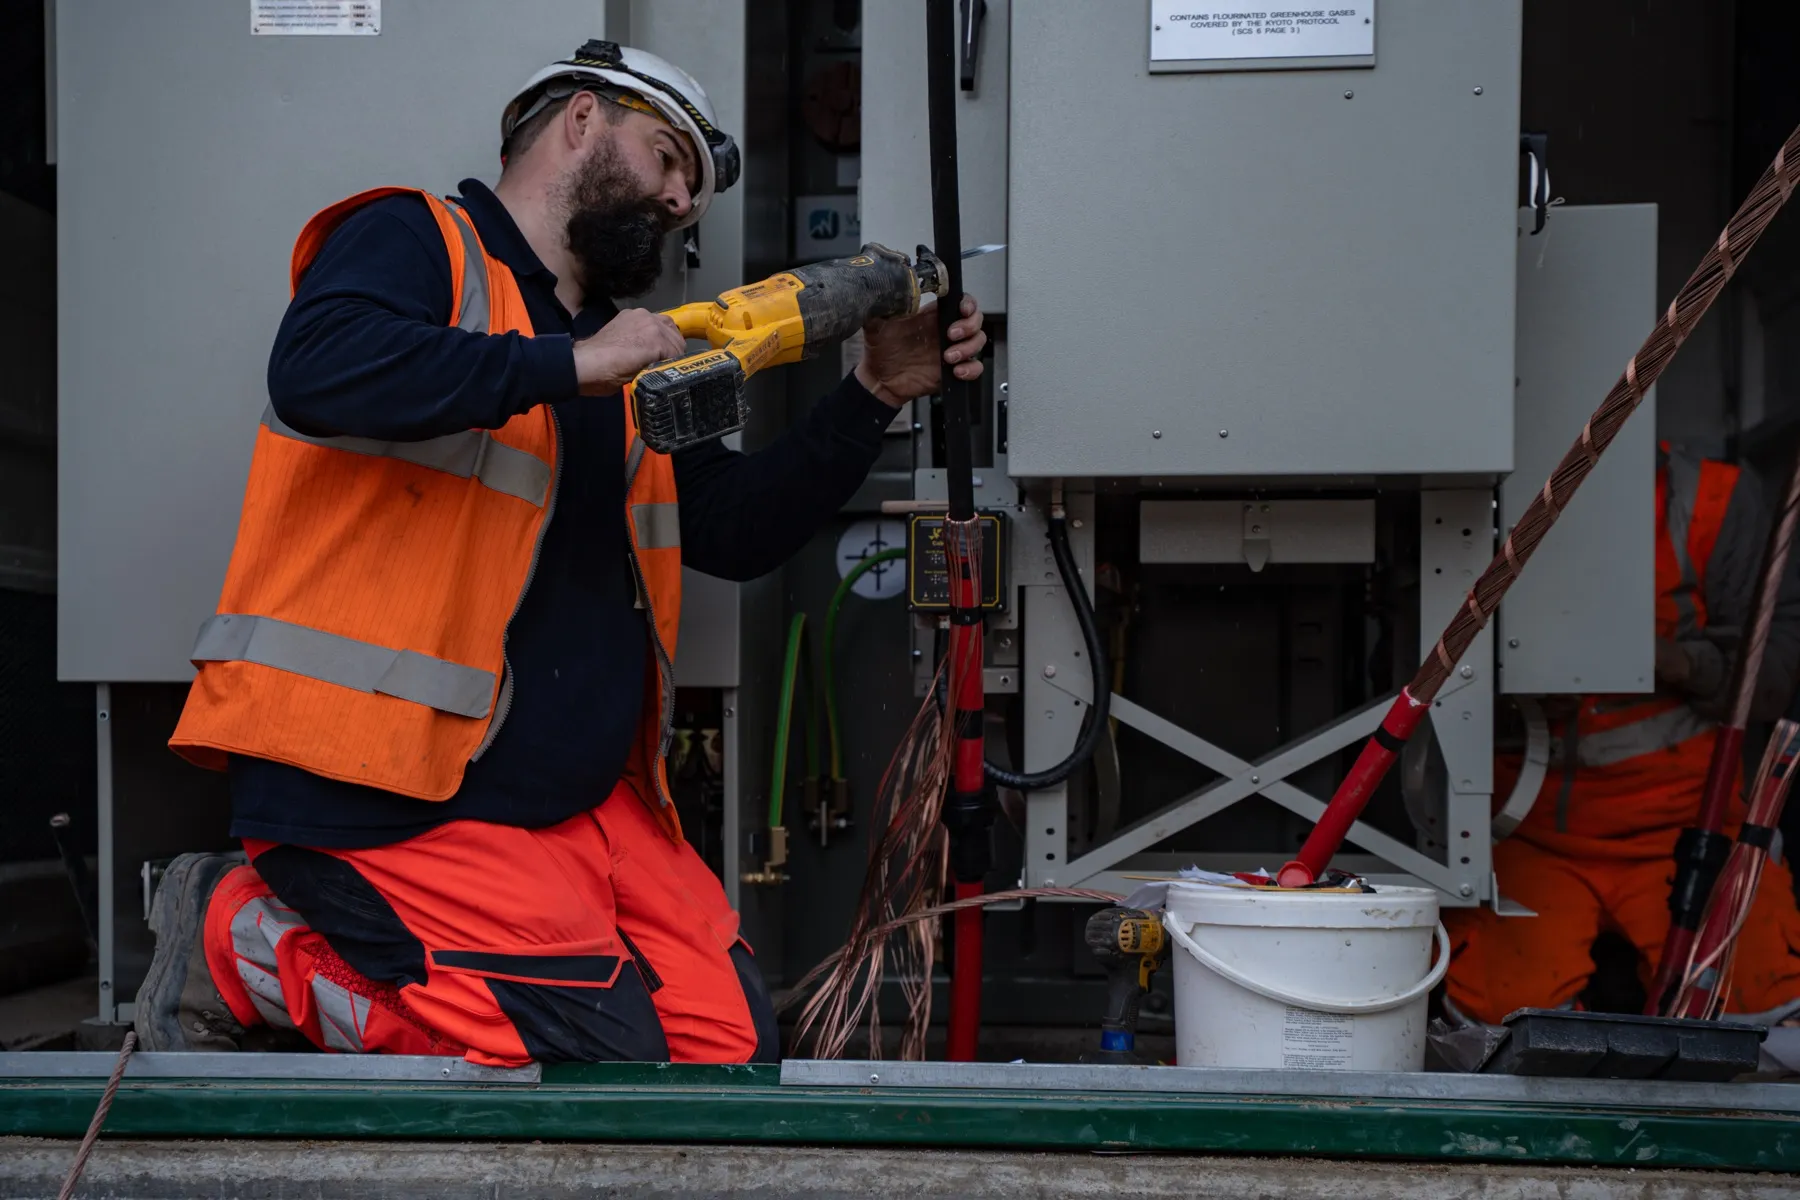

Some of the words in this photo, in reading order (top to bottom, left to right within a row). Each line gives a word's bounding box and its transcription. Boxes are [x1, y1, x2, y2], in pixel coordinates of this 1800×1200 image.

[1213, 12, 1267, 20] FLOURINATED
[1270, 11, 1325, 19] GREENHOUSE
[1328, 9, 1356, 17] GASES
[663, 368, 680, 378] 5
